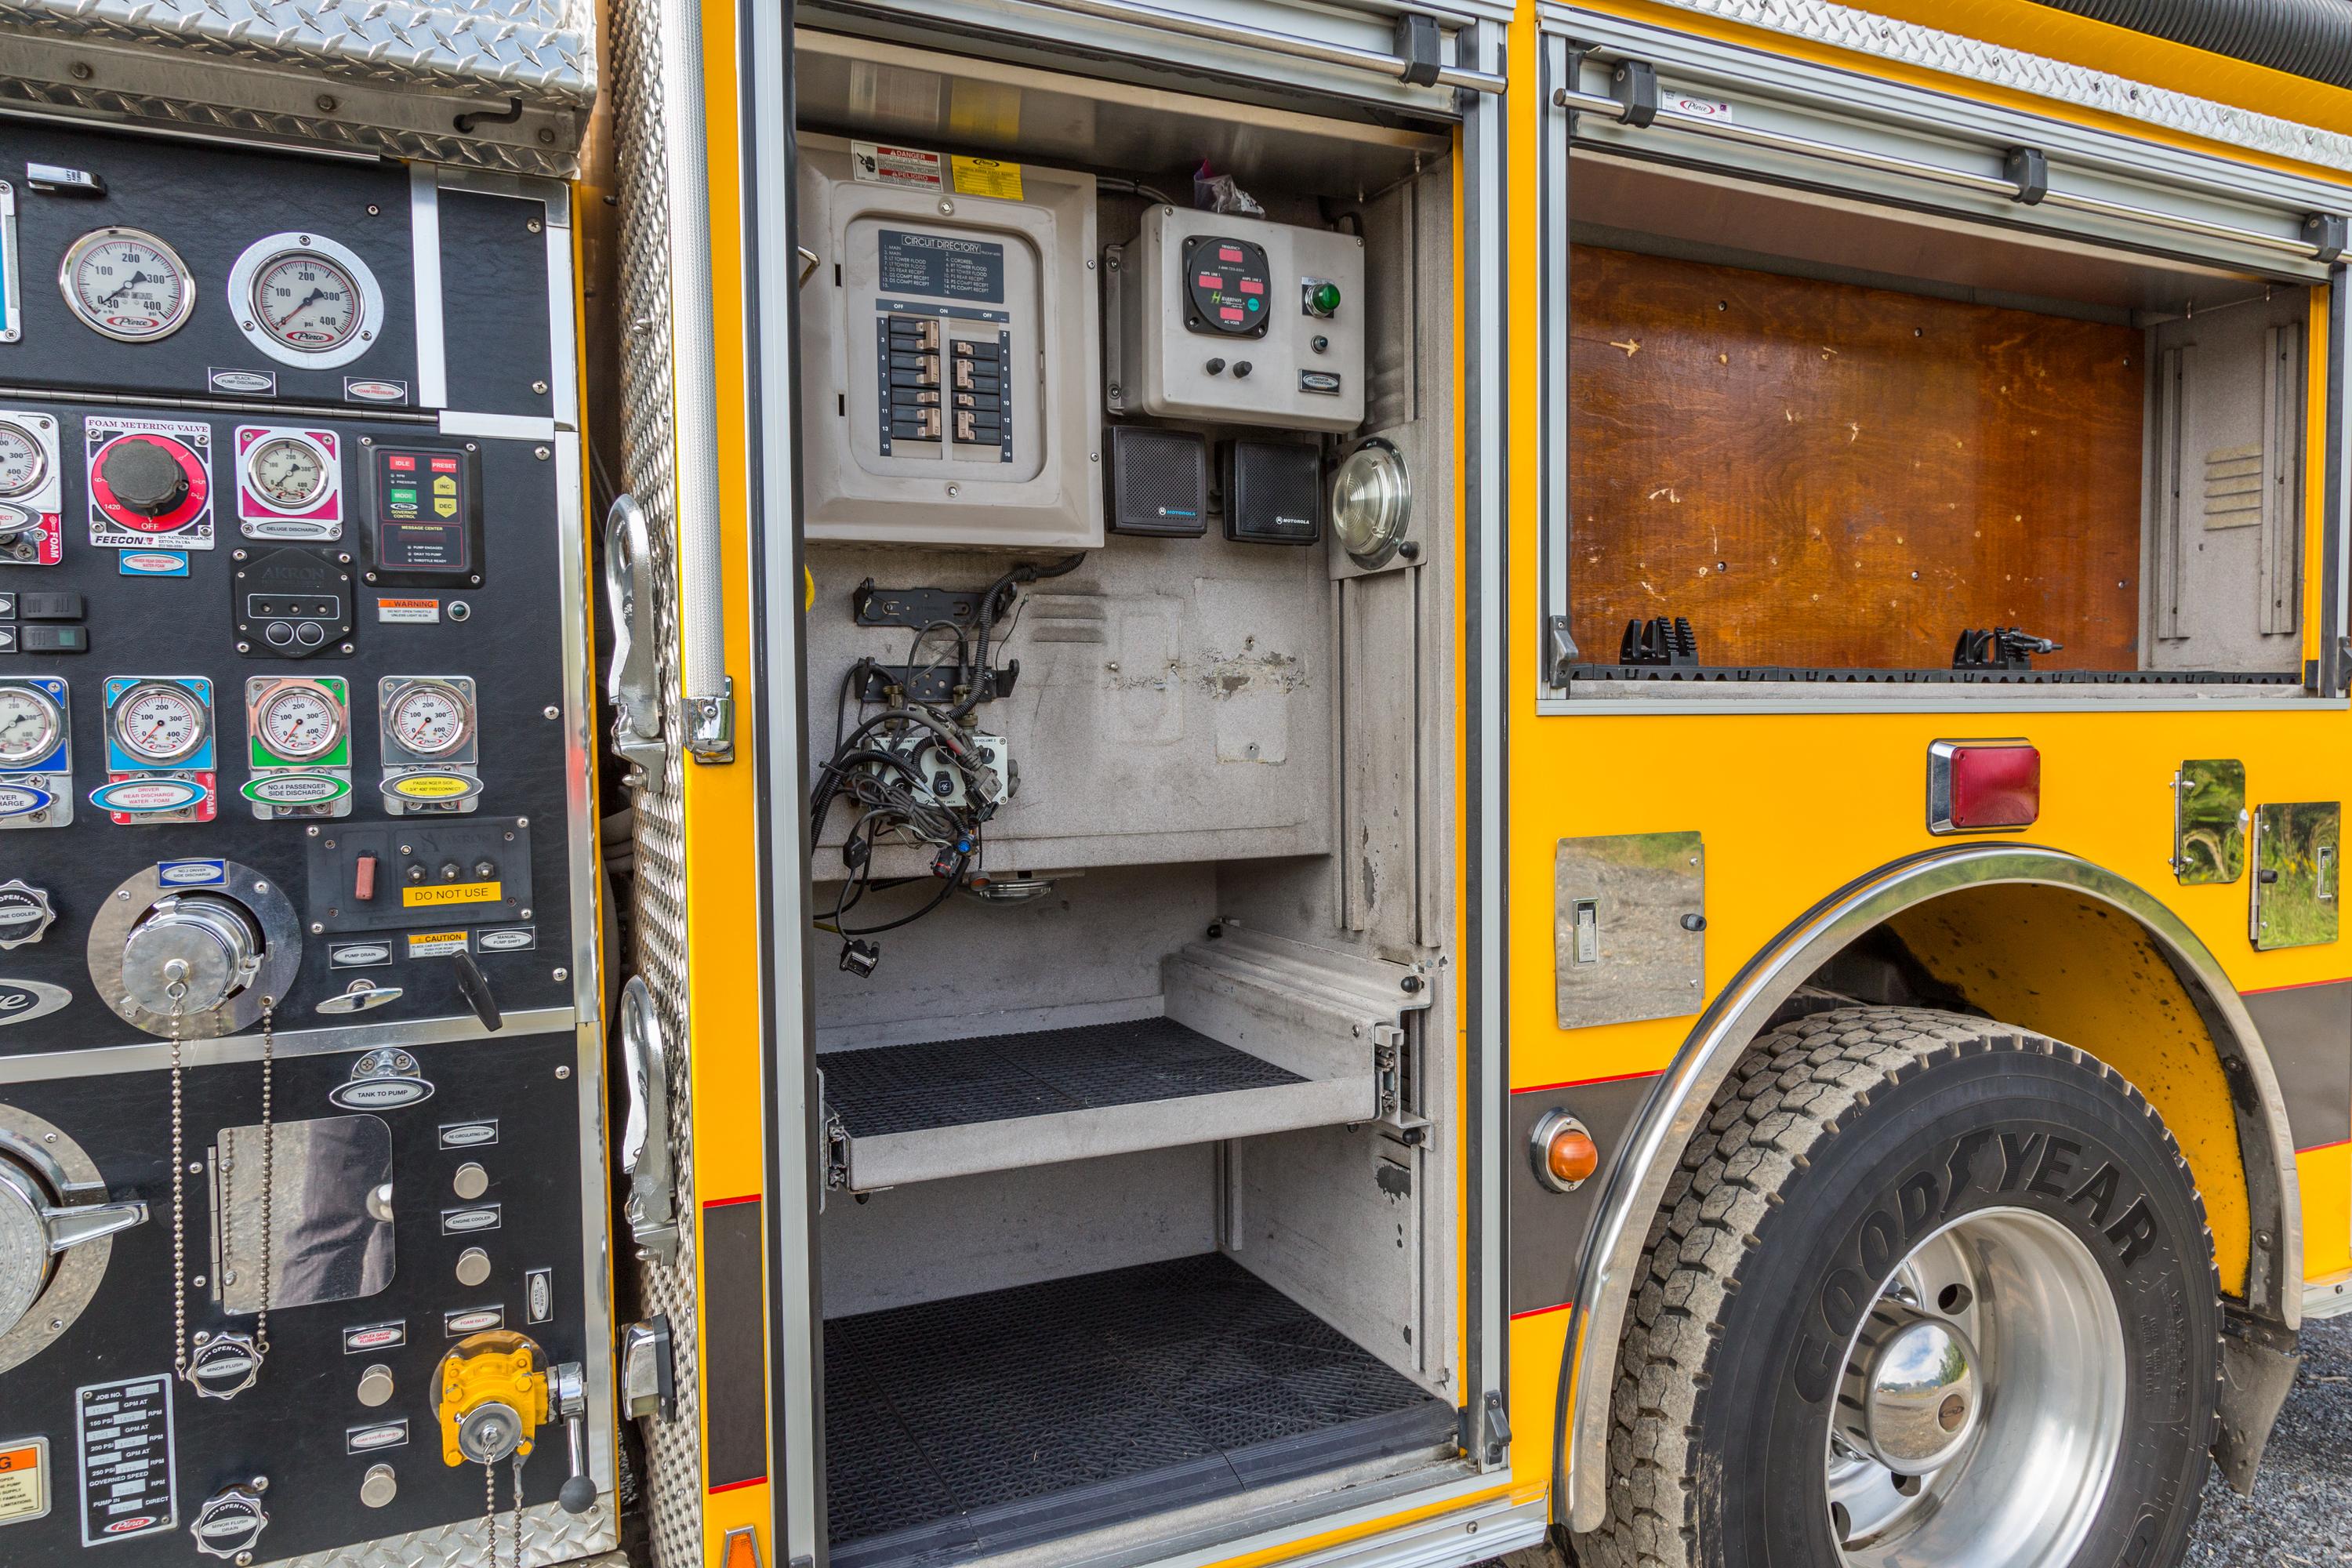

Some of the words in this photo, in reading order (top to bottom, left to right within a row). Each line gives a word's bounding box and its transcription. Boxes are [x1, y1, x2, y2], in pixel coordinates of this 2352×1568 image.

[1687, 101, 1708, 111] Pierce
[895, 150, 926, 160] DANGER
[897, 171, 928, 181] PELIGRO
[904, 236, 935, 247] CIRCUIT
[937, 240, 979, 252] DIRECTORY
[122, 253, 140, 263] 200
[96, 266, 113, 276] 100
[147, 274, 165, 285] 300
[298, 272, 315, 281] 200
[276, 288, 291, 297] 100
[324, 292, 339, 301] 300
[143, 301, 162, 310] 400
[119, 318, 149, 327] Pierce
[319, 317, 336, 325] 400
[298, 332, 325, 341] Pierce
[121, 421, 174, 431] METERING
[177, 424, 209, 433] VALVE
[95, 535, 143, 544] FEECON
[49, 532, 60, 559] FOAM
[262, 567, 325, 579] AKRON
[416, 891, 432, 901] DO
[437, 889, 460, 899] NOT
[465, 887, 488, 897] USE
[425, 934, 462, 942] CAUTION
[1793, 1129, 2159, 1404] GOODYEAR
[95, 1392, 109, 1401] JOB
[89, 1475, 125, 1486] GOVERNED
[127, 1471, 149, 1479] SPEED
[93, 1499, 113, 1508] PUMP
[145, 1496, 169, 1505] DIRECT
